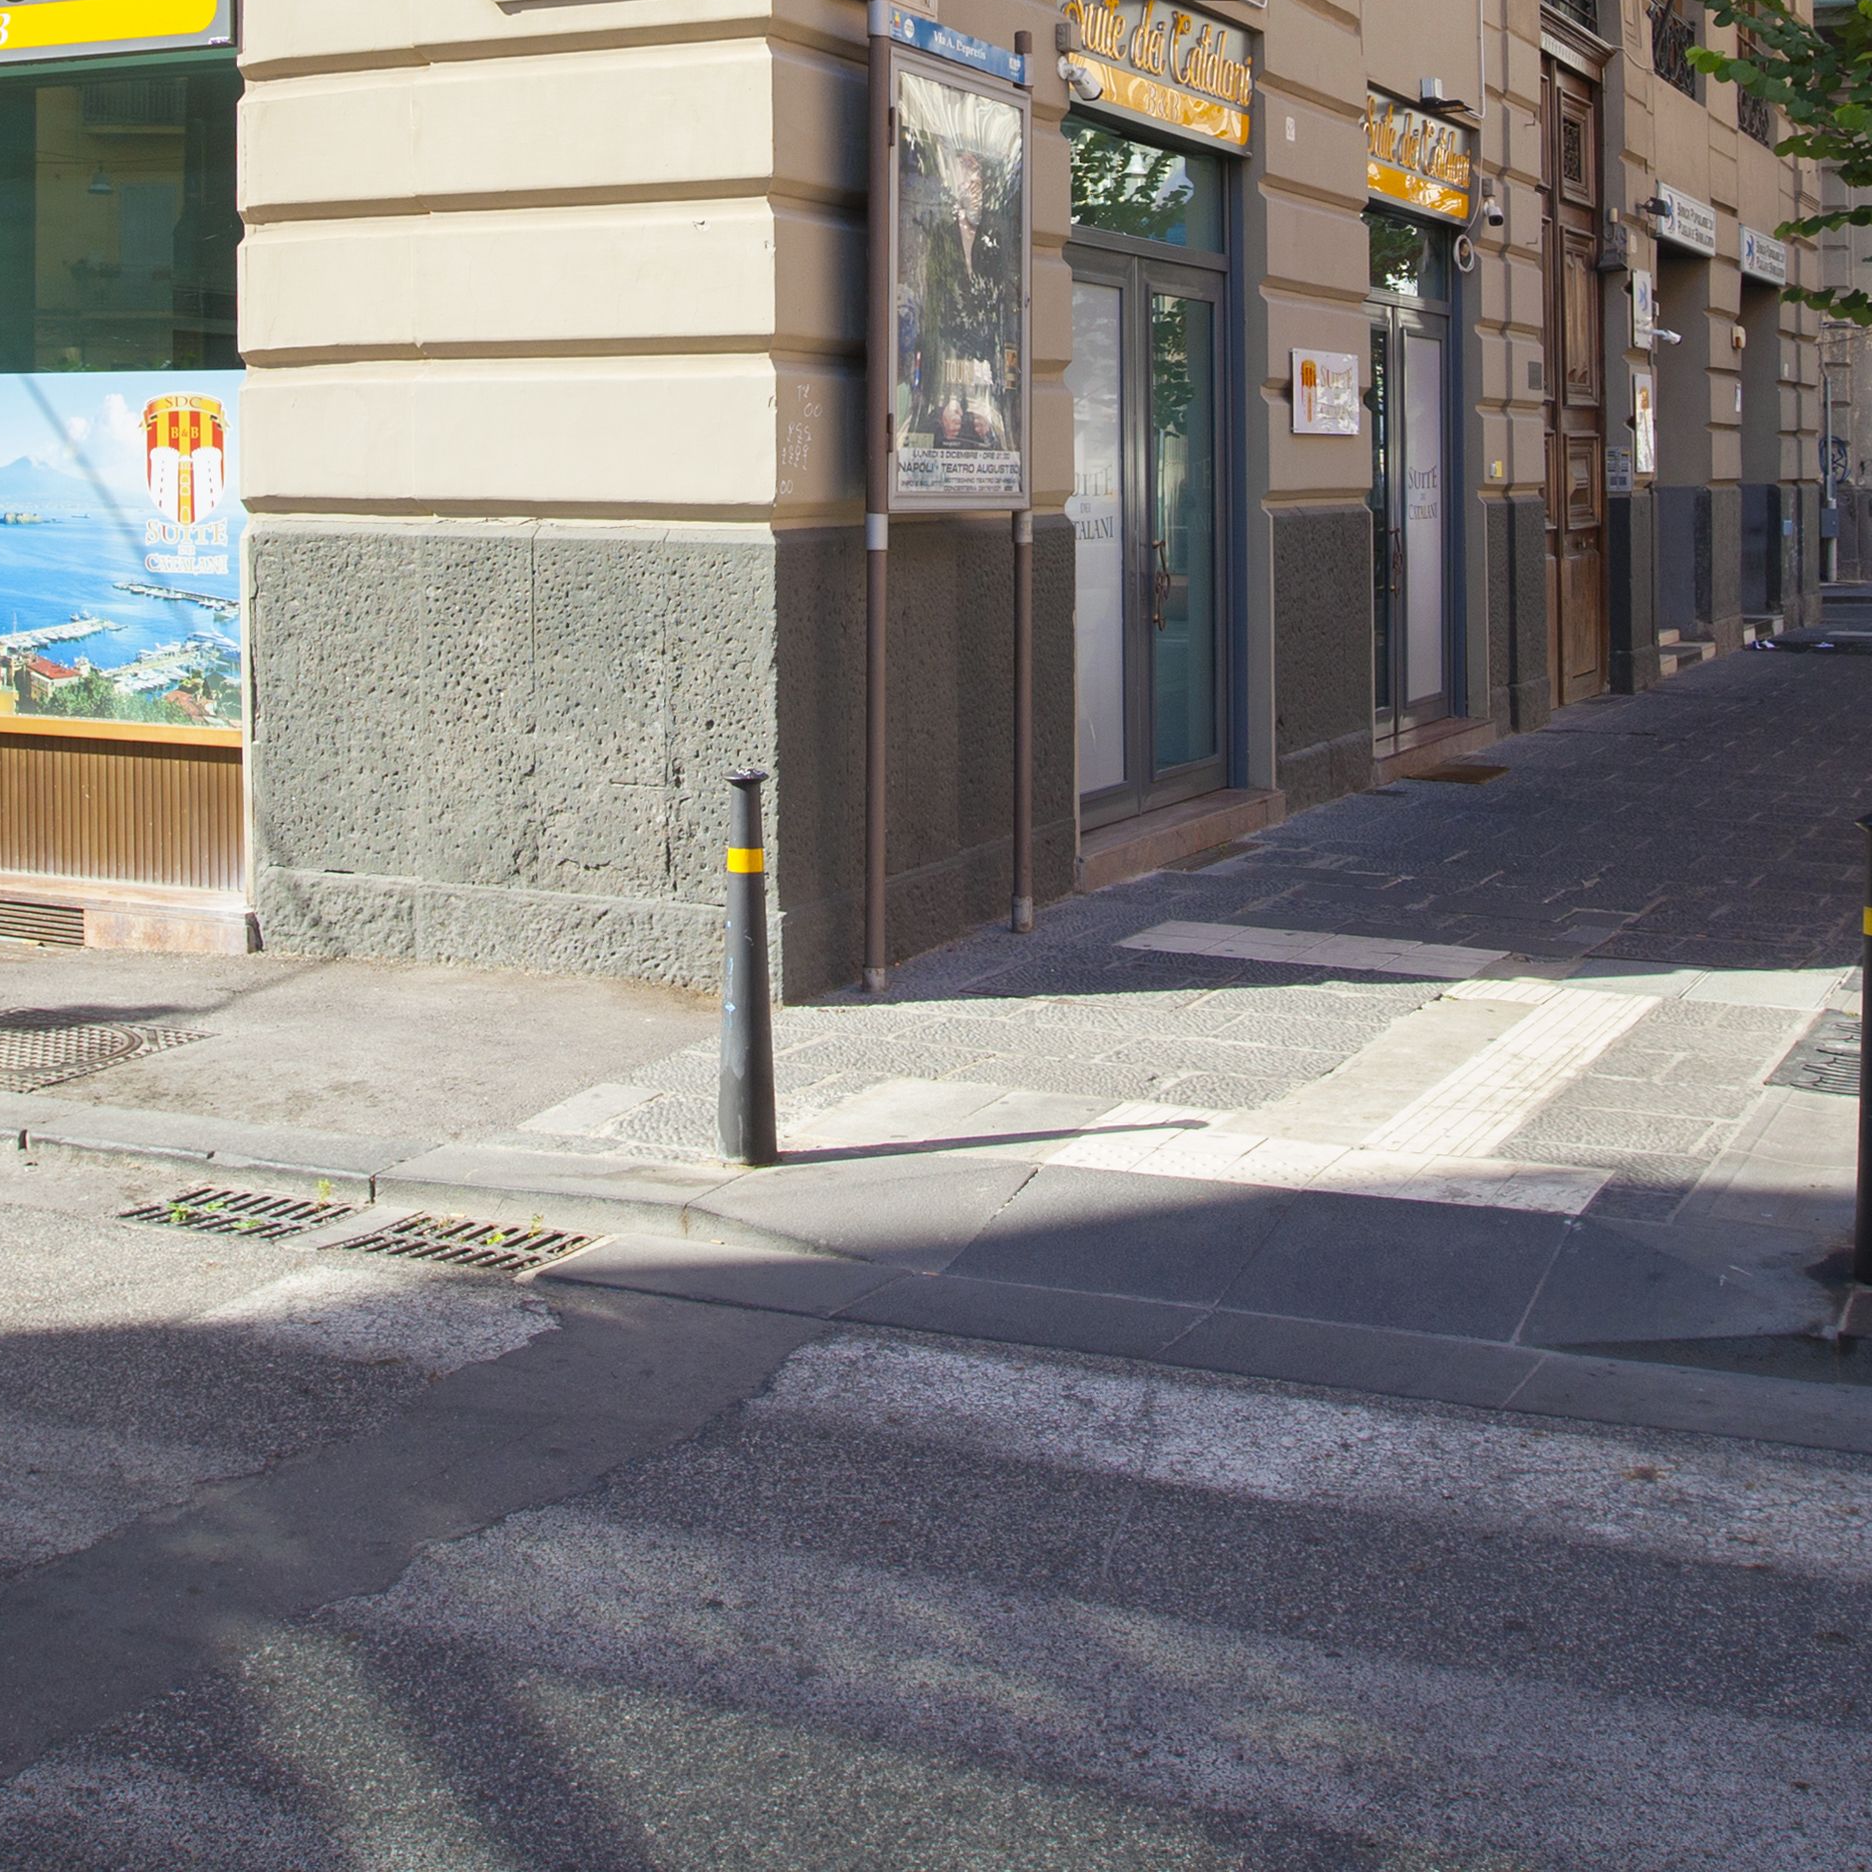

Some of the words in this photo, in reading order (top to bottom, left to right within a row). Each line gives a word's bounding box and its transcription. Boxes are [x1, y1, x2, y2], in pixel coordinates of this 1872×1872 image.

[932, 30, 946, 45] Via
[947, 35, 955, 49] A.
[956, 40, 986, 61] Depretis
[1130, 0, 1167, 76] dei
[1170, 11, 1253, 107] Catalani
[163, 395, 203, 409] SDC
[945, 450, 978, 460] DICEMBRE
[898, 461, 935, 473] NAPOLI
[941, 463, 975, 474] TEATRO
[976, 463, 1020, 475] AUGUSTEO
[1409, 465, 1437, 489] SUITE
[1080, 502, 1091, 513] DEI
[145, 519, 227, 546] SUITE
[145, 555, 228, 576] CATALANI
